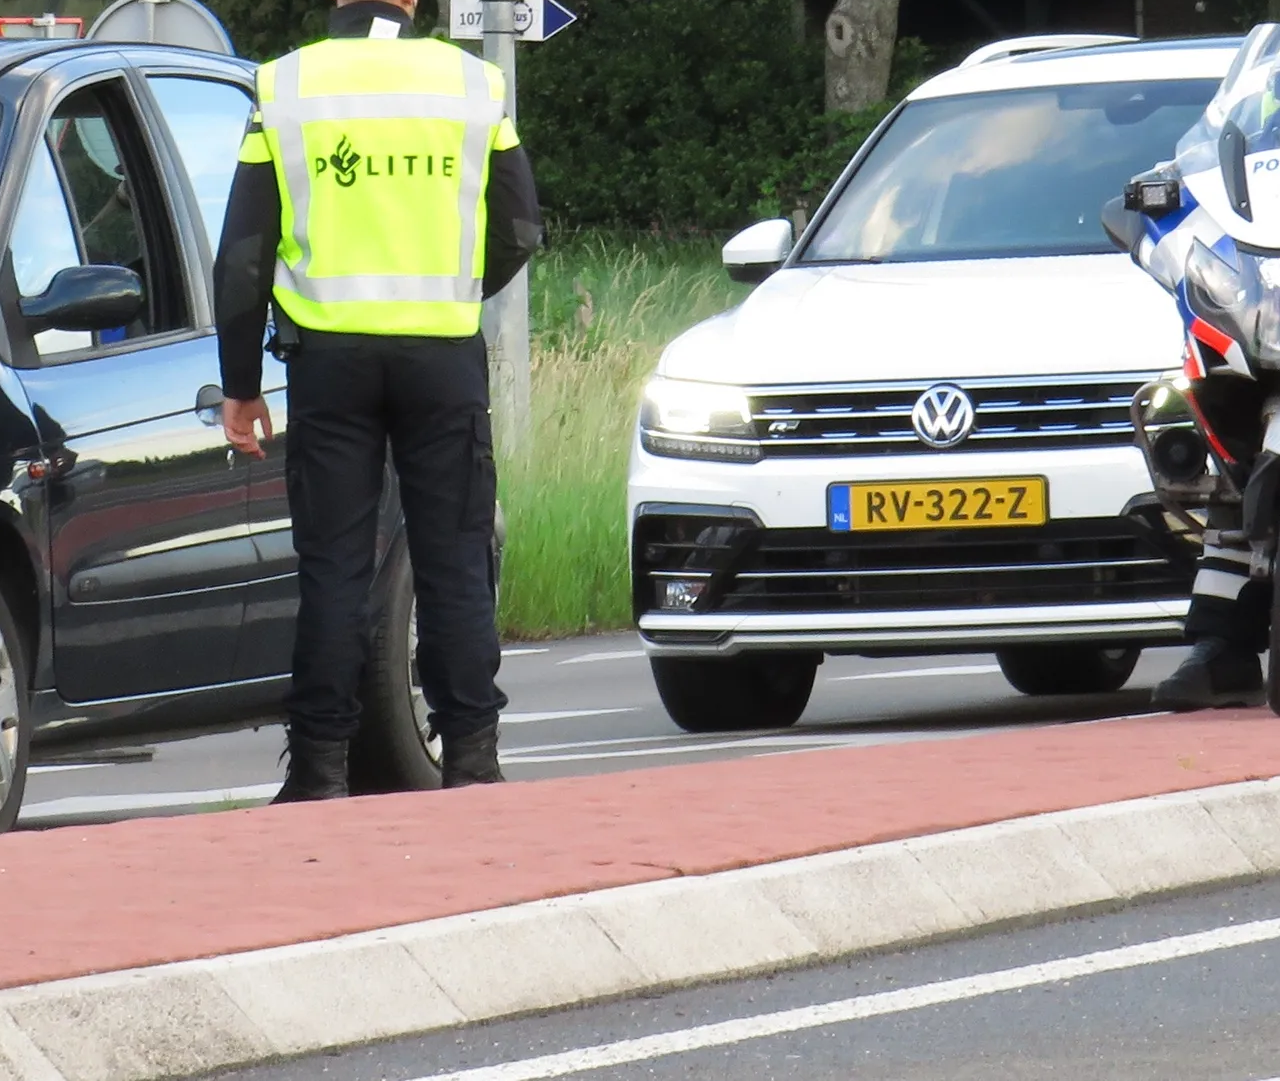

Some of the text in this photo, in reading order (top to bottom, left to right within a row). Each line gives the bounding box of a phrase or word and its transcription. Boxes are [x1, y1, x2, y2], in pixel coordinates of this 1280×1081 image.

[460, 12, 482, 25] 107
[834, 486, 1028, 524] NL RV-322-Z
